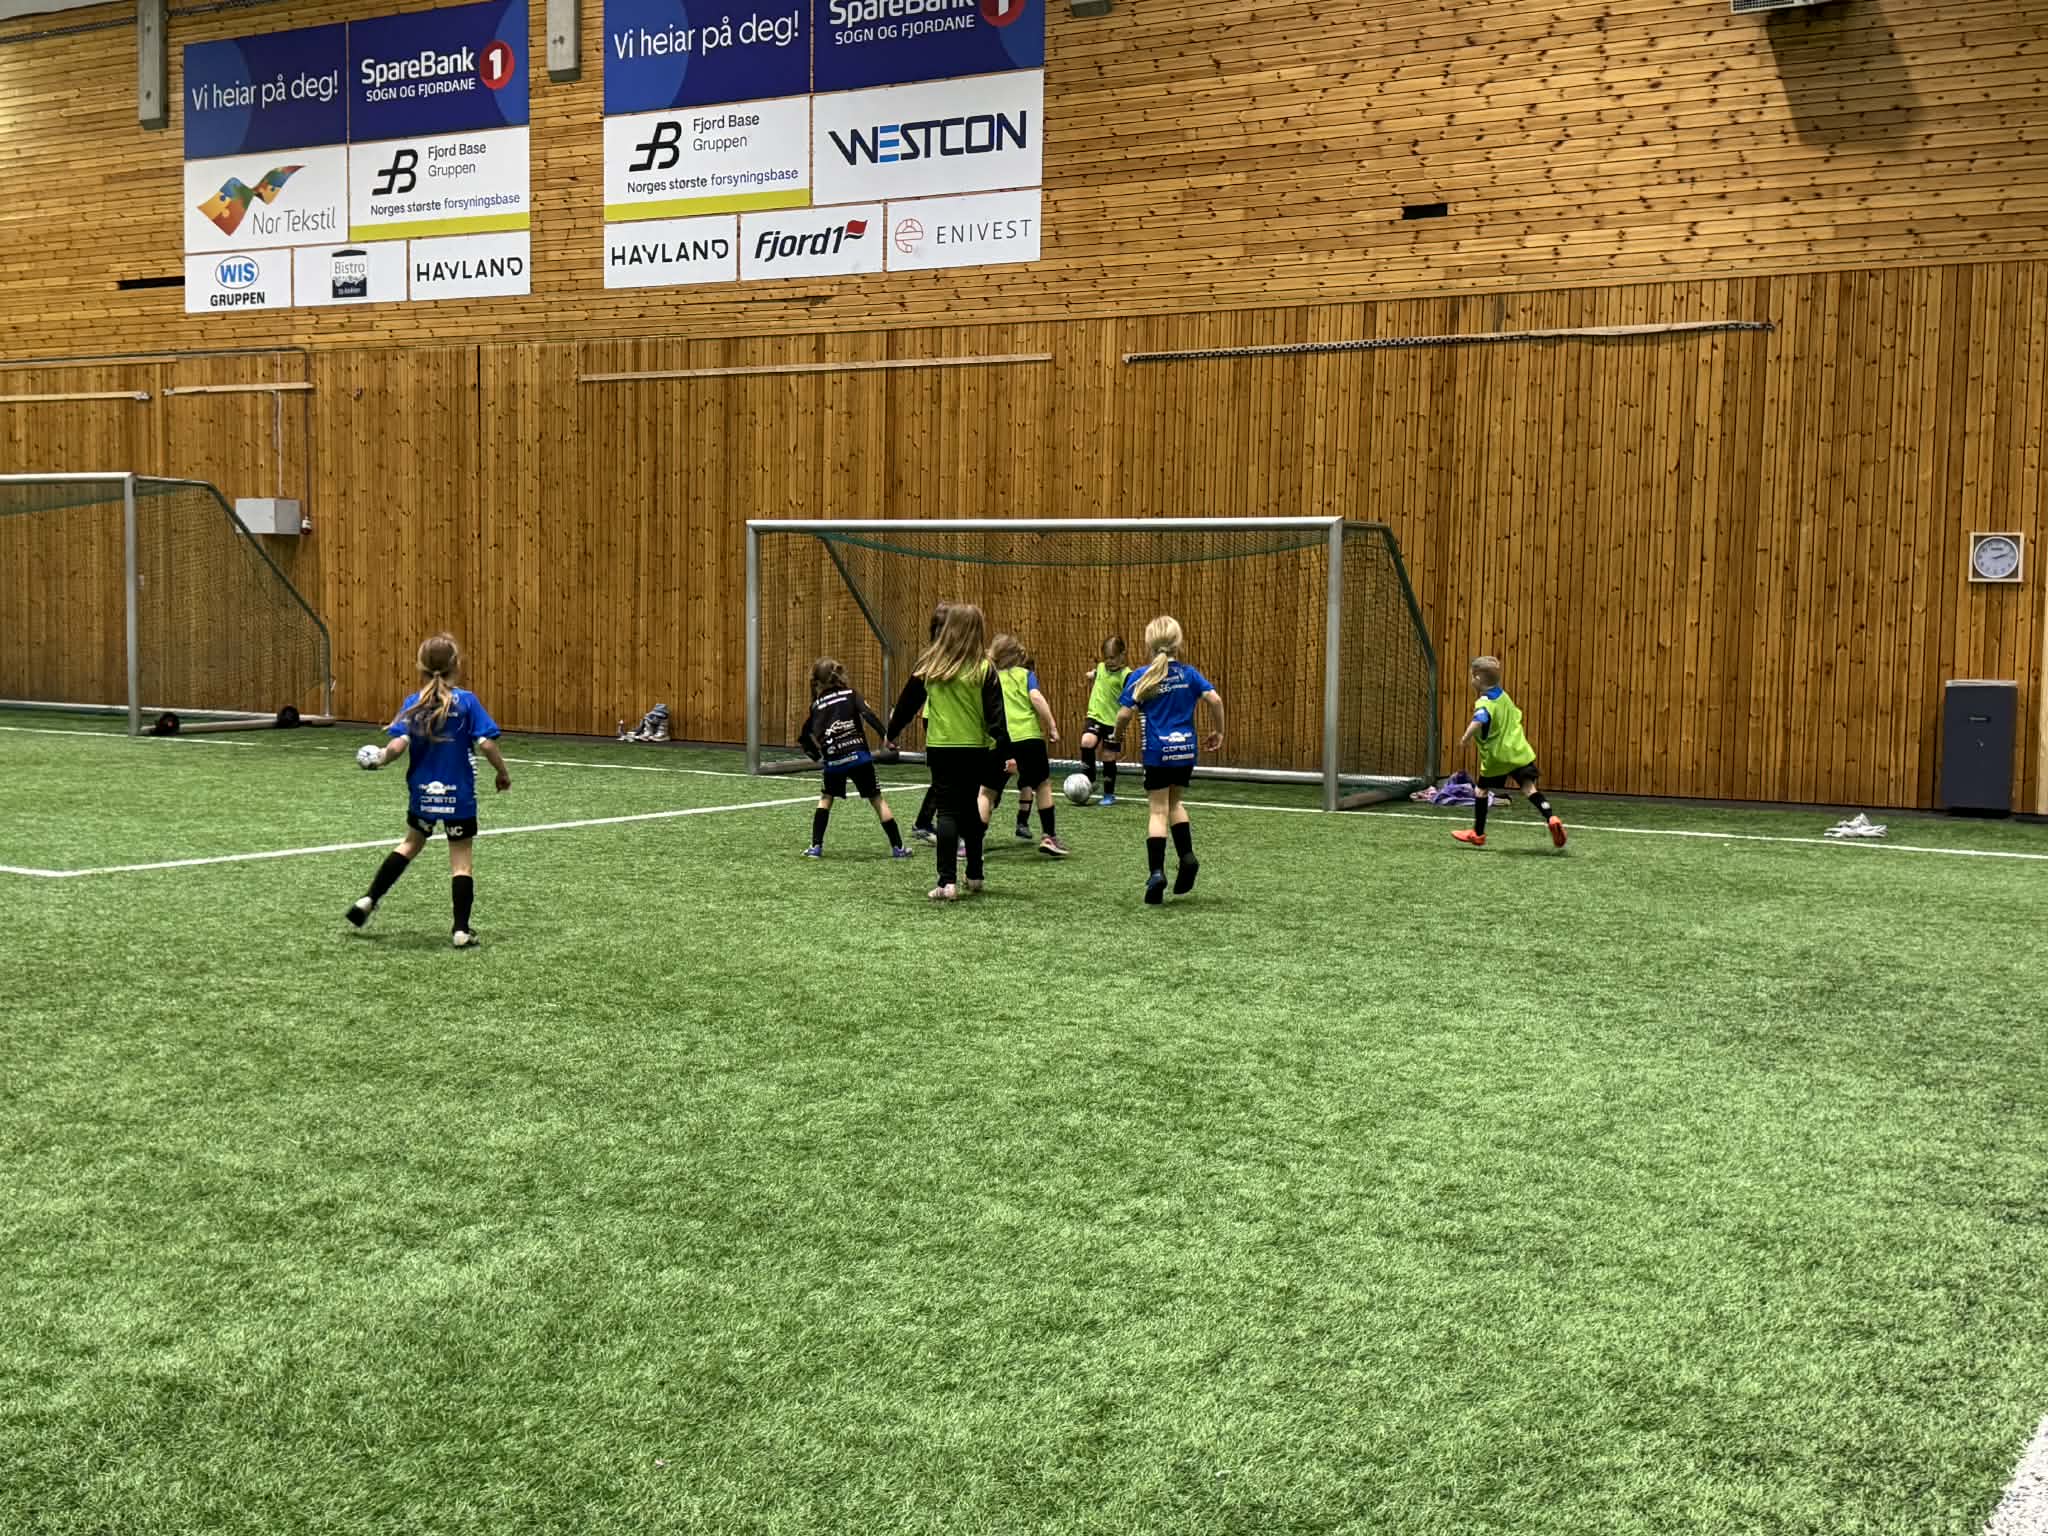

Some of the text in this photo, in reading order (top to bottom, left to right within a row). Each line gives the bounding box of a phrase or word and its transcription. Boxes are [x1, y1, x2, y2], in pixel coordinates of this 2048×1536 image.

[830, 0, 975, 28] SpareBan
[613, 11, 799, 59] Vi heiar på deg!
[835, 14, 975, 45] SOGN OG FJORDANE
[361, 46, 502, 86] SpareBank 1
[192, 70, 338, 110] Vi heiar på deg!
[366, 78, 476, 102] SOGN OG FJORDANE
[692, 113, 760, 133] Fjord Base
[692, 134, 748, 152] Gruppen
[827, 110, 1027, 165] WESTCON
[428, 143, 487, 160] Fjord Base
[427, 163, 476, 179] Gruppen
[627, 167, 799, 195] Norges største forsyningsbase
[370, 193, 521, 217] Norges største forsyningsbase
[252, 207, 336, 235] Nor Tekstil
[936, 218, 1033, 245] ENIVEST
[610, 238, 729, 267] HAVLAND
[754, 225, 844, 262] Fjord1
[220, 262, 256, 284] WIS
[334, 261, 366, 274] Bistro
[416, 256, 523, 283] HAVLAND
[210, 291, 265, 307] GRUPPEN
